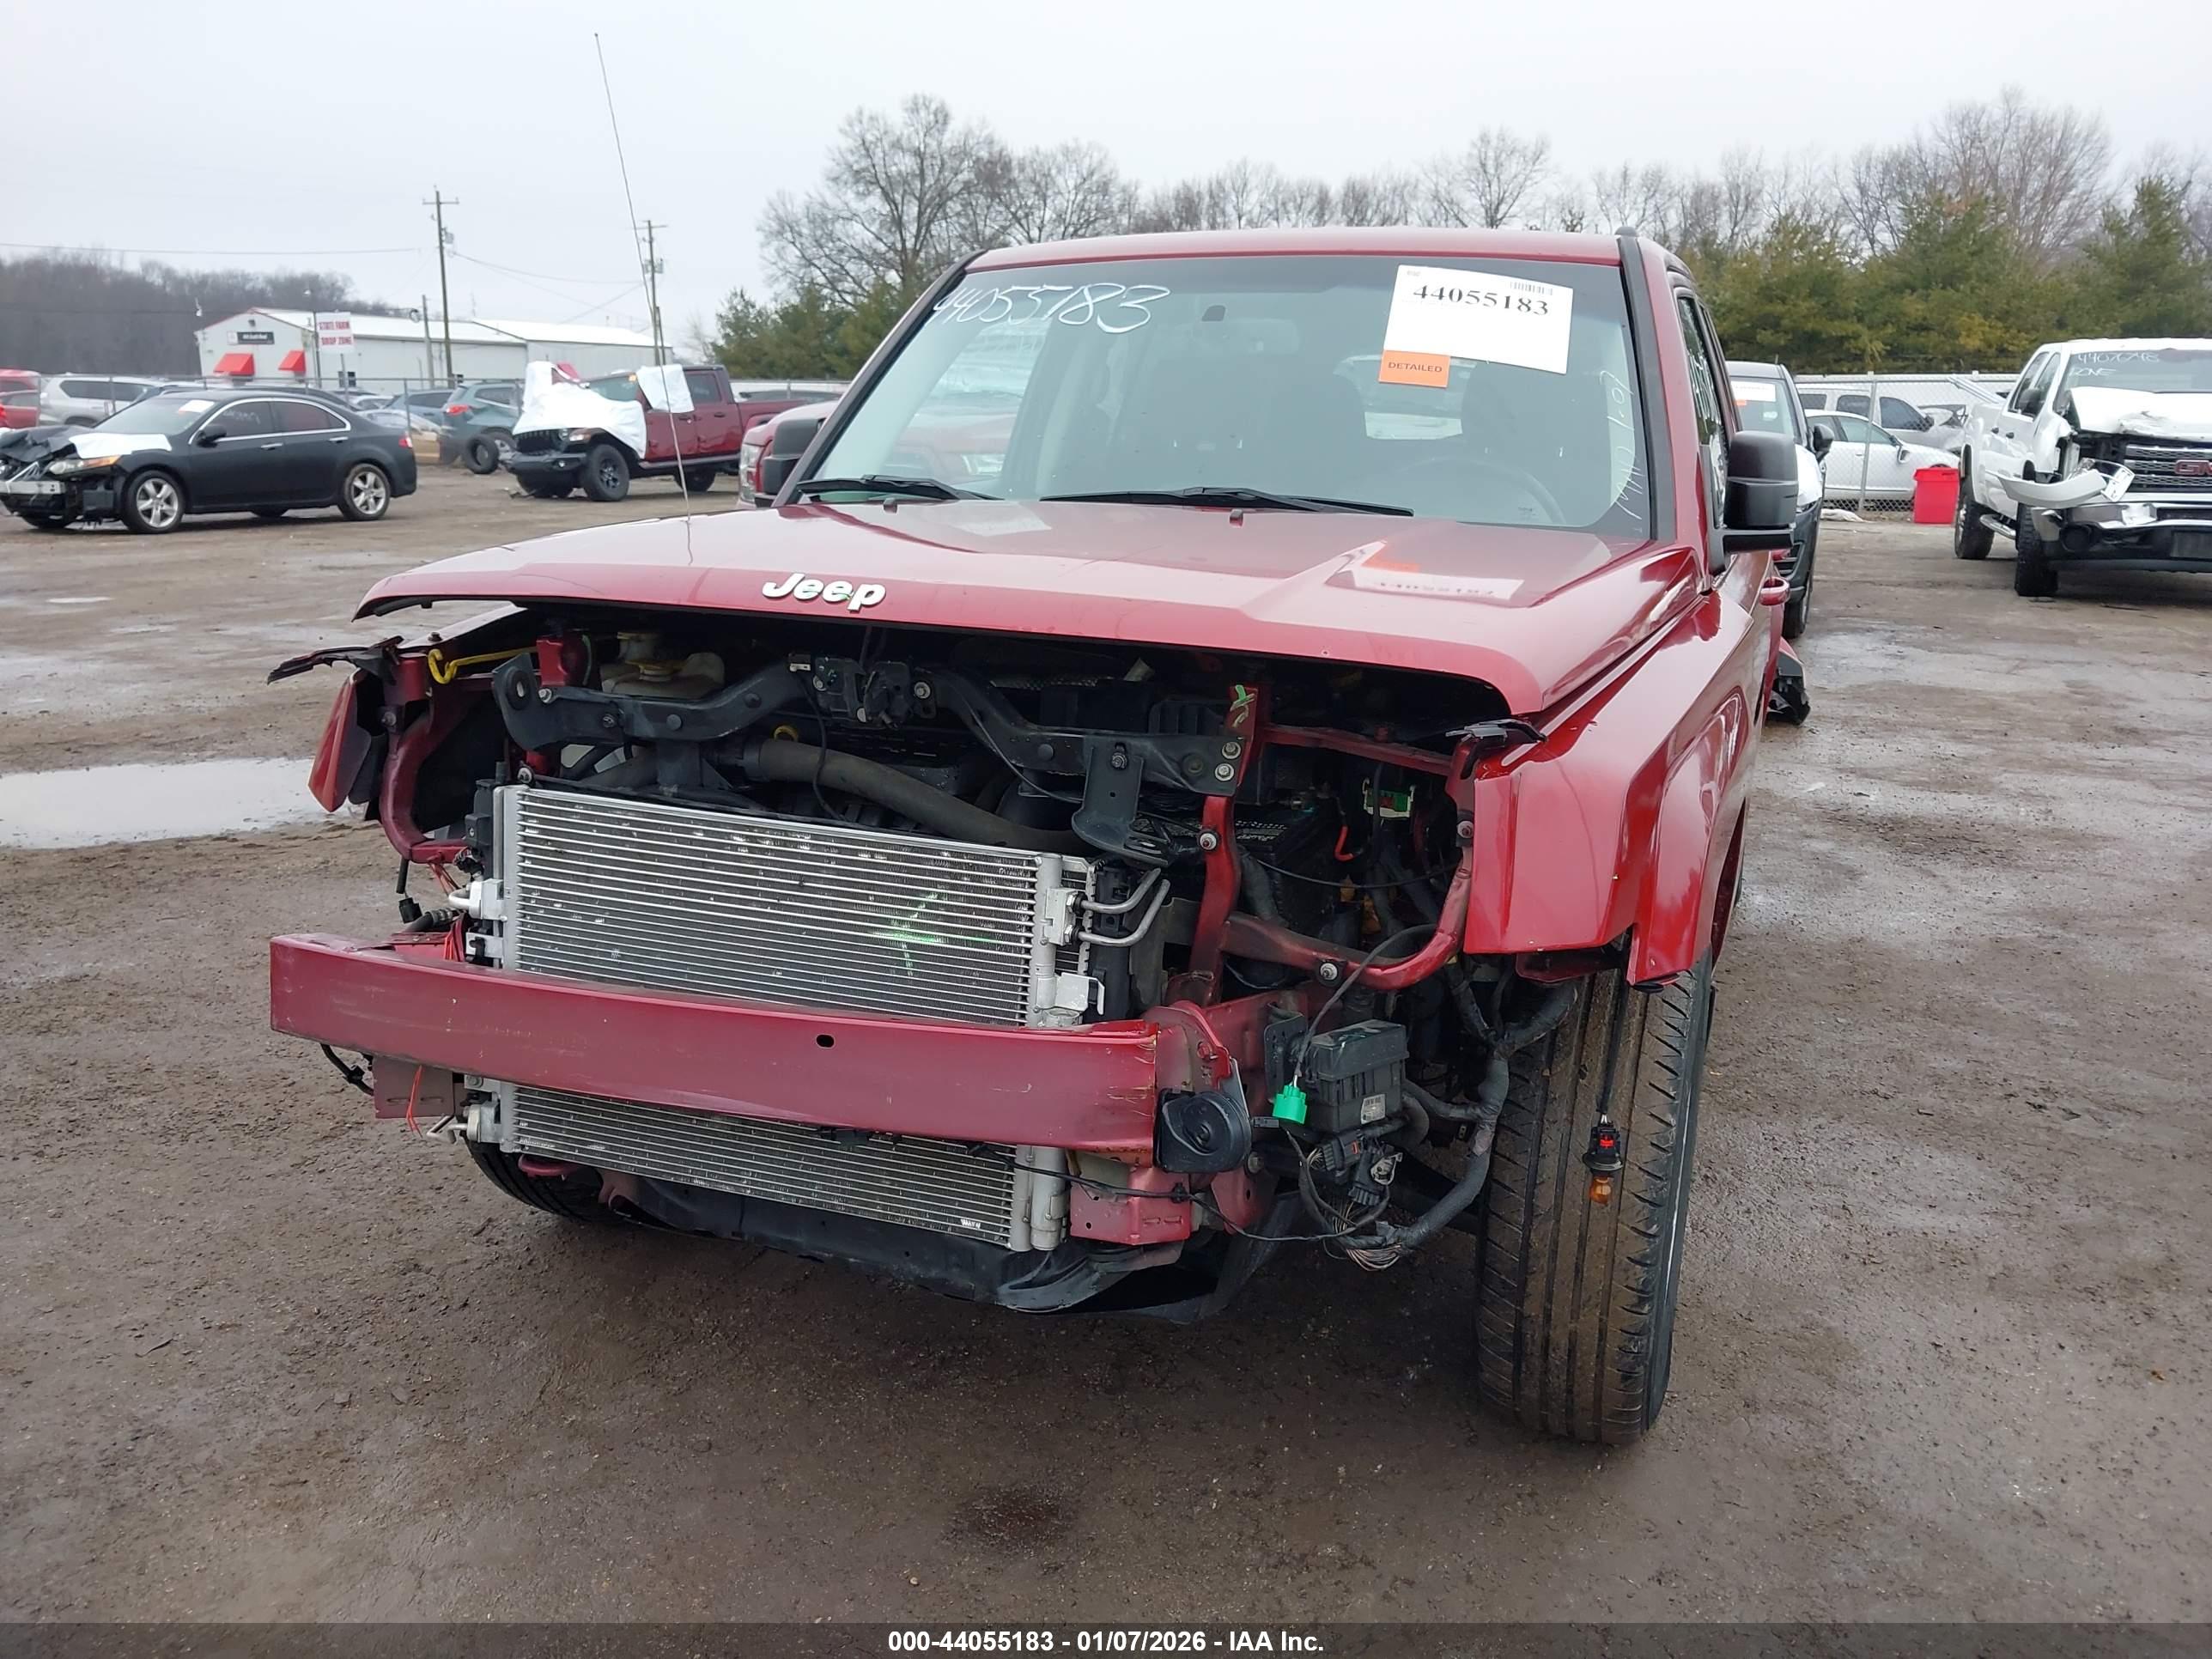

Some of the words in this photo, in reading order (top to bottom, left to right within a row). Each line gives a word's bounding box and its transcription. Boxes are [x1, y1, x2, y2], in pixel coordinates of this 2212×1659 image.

[1413, 284, 1549, 315] 44055183
[1388, 362, 1443, 373] DETAILED
[762, 573, 887, 611] Jeep
